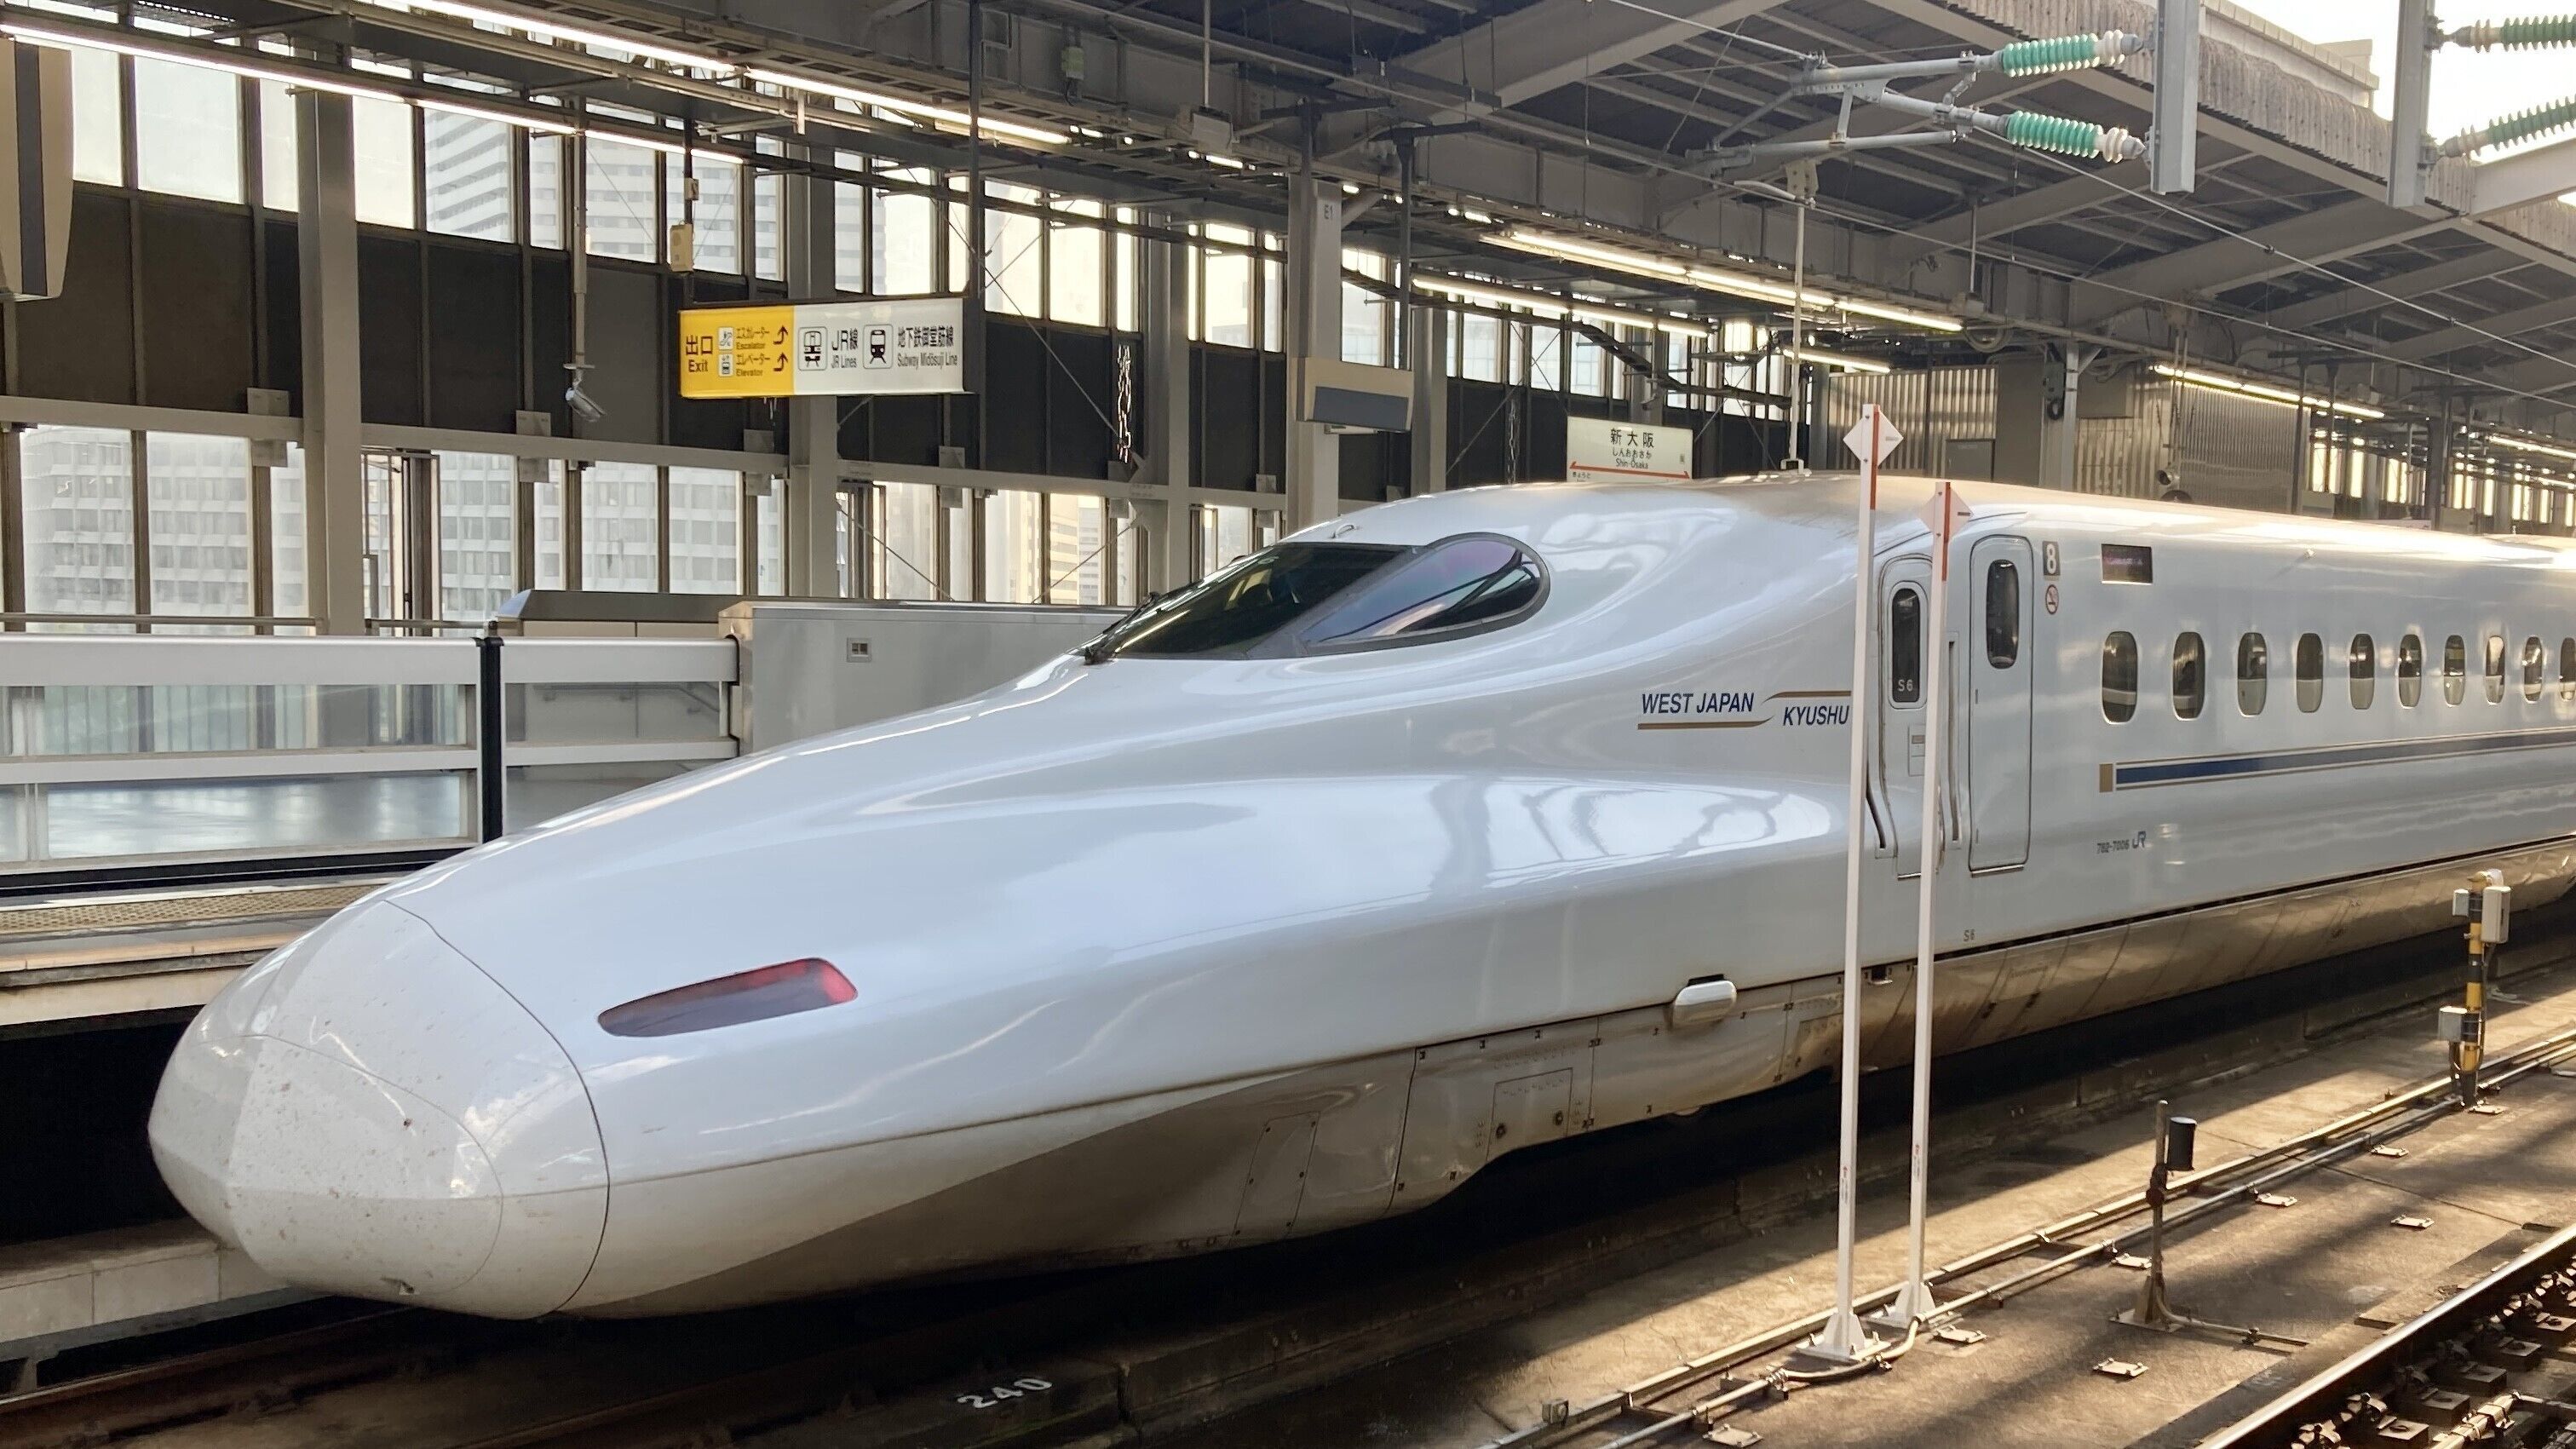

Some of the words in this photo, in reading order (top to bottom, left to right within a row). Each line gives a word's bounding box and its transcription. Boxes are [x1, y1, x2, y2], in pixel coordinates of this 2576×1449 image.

[686, 335, 713, 356] 出口
[831, 328, 858, 350] JR線
[898, 325, 953, 348] 地下鉄御堂筋線
[688, 359, 708, 373] Exit
[736, 354, 770, 365] エレベーター
[831, 354, 839, 368] JR
[841, 354, 857, 368] Lines
[898, 353, 918, 370] Subway
[946, 352, 957, 365] Line
[1610, 428, 1654, 448] 新大阪
[1613, 447, 1652, 459] しんおおさか
[2046, 543, 2057, 575] 8
[1898, 679, 1913, 692] S6
[1642, 693, 1693, 714] WEST
[1696, 693, 1754, 714] JAPAN
[1782, 705, 1849, 726] KYUSHU
[2132, 831, 2146, 848] JR
[957, 1378, 1053, 1408] 240
